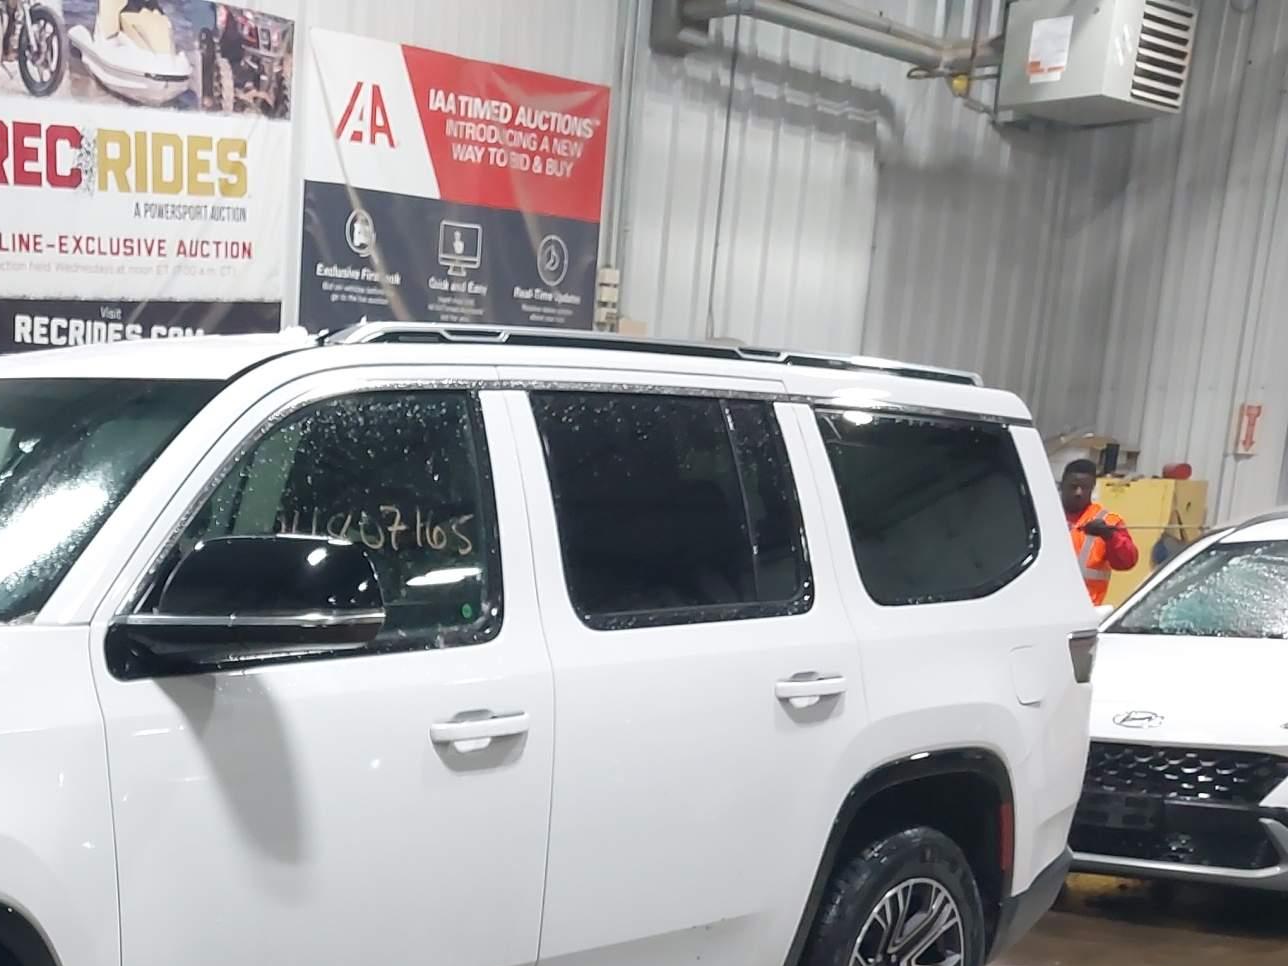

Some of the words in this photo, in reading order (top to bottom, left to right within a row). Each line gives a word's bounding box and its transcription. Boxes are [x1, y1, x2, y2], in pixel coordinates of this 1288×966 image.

[429, 88, 456, 115] IAA
[457, 95, 512, 124] TIMED
[539, 135, 550, 153] A
[552, 137, 584, 158] NEW
[451, 142, 485, 164] WAY
[488, 147, 509, 168] TO
[531, 155, 543, 174] &
[545, 157, 575, 178] BUY
[133, 202, 141, 217] A
[143, 202, 209, 221] POWERSPORT
[210, 205, 247, 222] AUCTION
[176, 239, 254, 260] AUCTION
[99, 305, 122, 320] Visit
